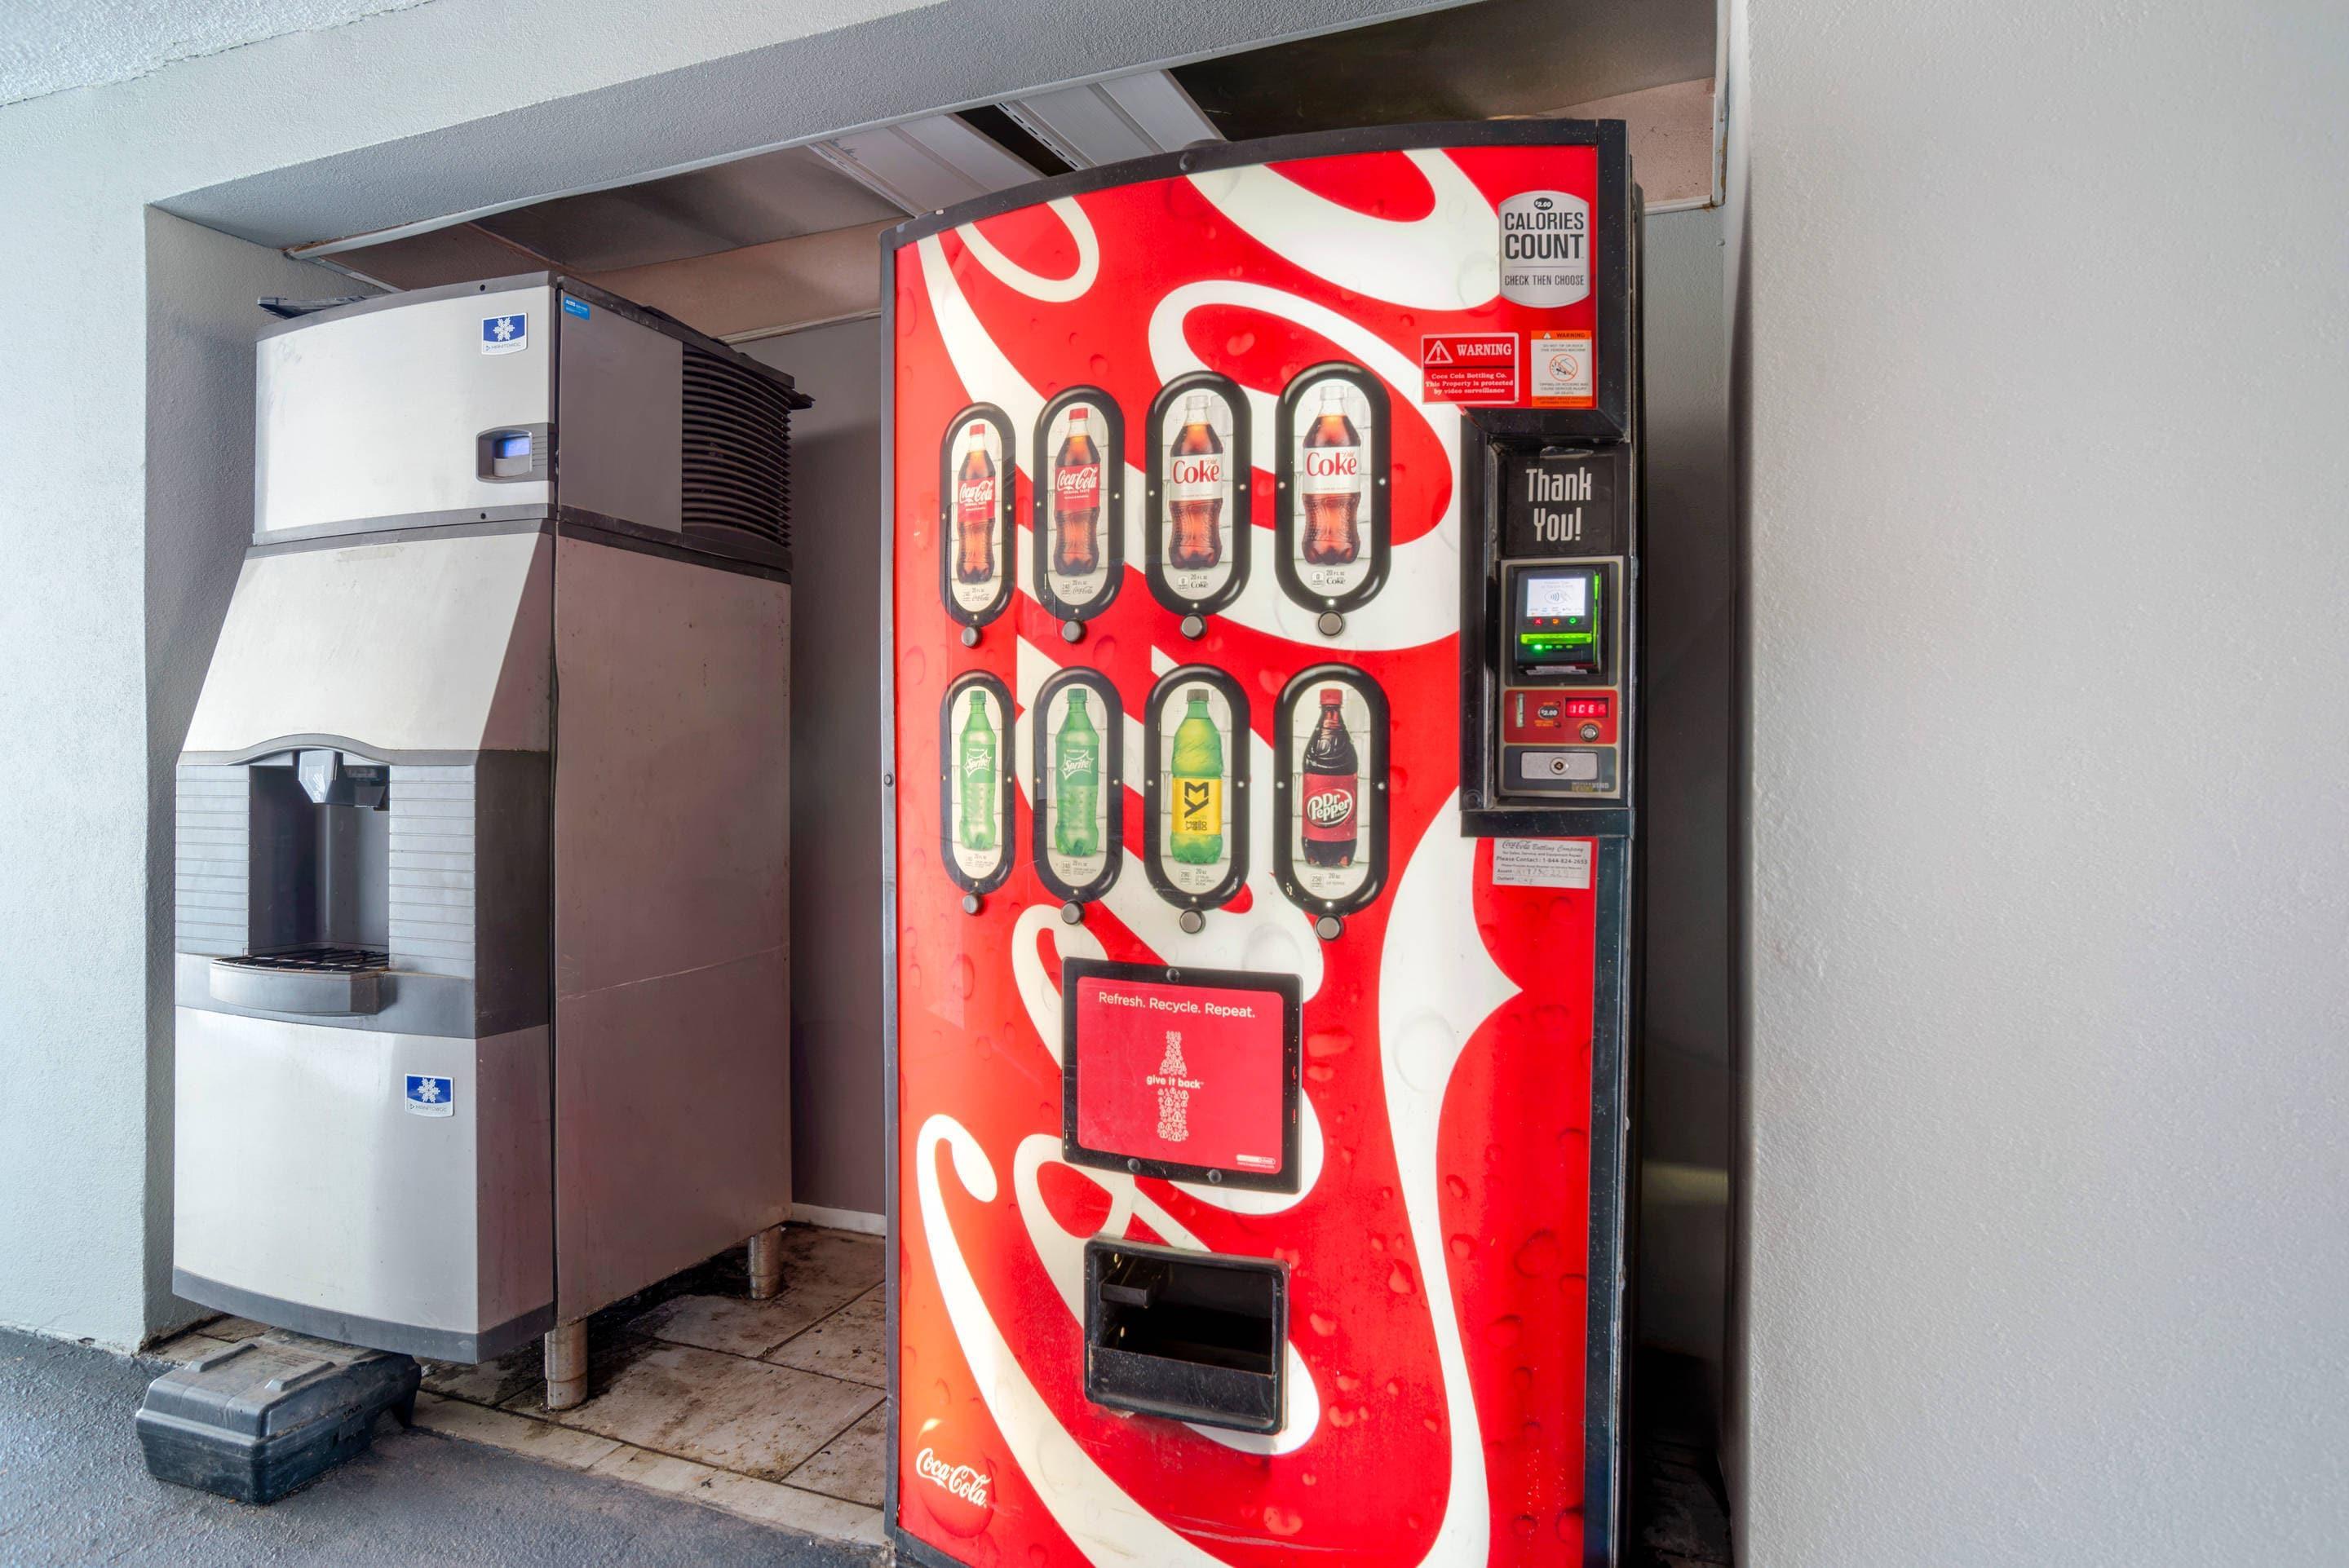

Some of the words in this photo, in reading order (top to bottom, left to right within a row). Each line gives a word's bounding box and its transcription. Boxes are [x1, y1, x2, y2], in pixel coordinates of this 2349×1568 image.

[1535, 200, 1552, 208] $2.00
[1504, 212, 1585, 231] CALORIES
[1505, 233, 1585, 260] COUNT
[1504, 275, 1529, 286] CHECK
[1533, 275, 1552, 285] THEN
[1555, 275, 1585, 285] CHOOSE
[1456, 343, 1512, 356] WARNING
[1442, 380, 1471, 388] Property
[1480, 379, 1514, 387] protected
[1467, 372, 1495, 380] Bottling
[1173, 459, 1219, 484] Coke
[1306, 452, 1357, 476] Coke
[1057, 466, 1098, 492] Coca-Cola
[1525, 466, 1593, 502] Thank
[959, 479, 993, 503] Coca-Cola
[1533, 507, 1582, 542] You!
[967, 757, 989, 771] Sprite
[1064, 758, 1090, 772] Sprite
[1307, 796, 1351, 821] Pepper
[1322, 793, 1341, 807] Dr
[1532, 843, 1555, 852] Bottling
[1556, 845, 1584, 854] Company
[1099, 992, 1146, 1008] Refresh.
[1149, 997, 1201, 1014] Recycle.
[1205, 1003, 1256, 1018] Repeat.
[1147, 1075, 1166, 1085] give
[1168, 1076, 1175, 1086] it
[1178, 1077, 1201, 1089] back
[916, 1447, 991, 1507] Coca-Cola
